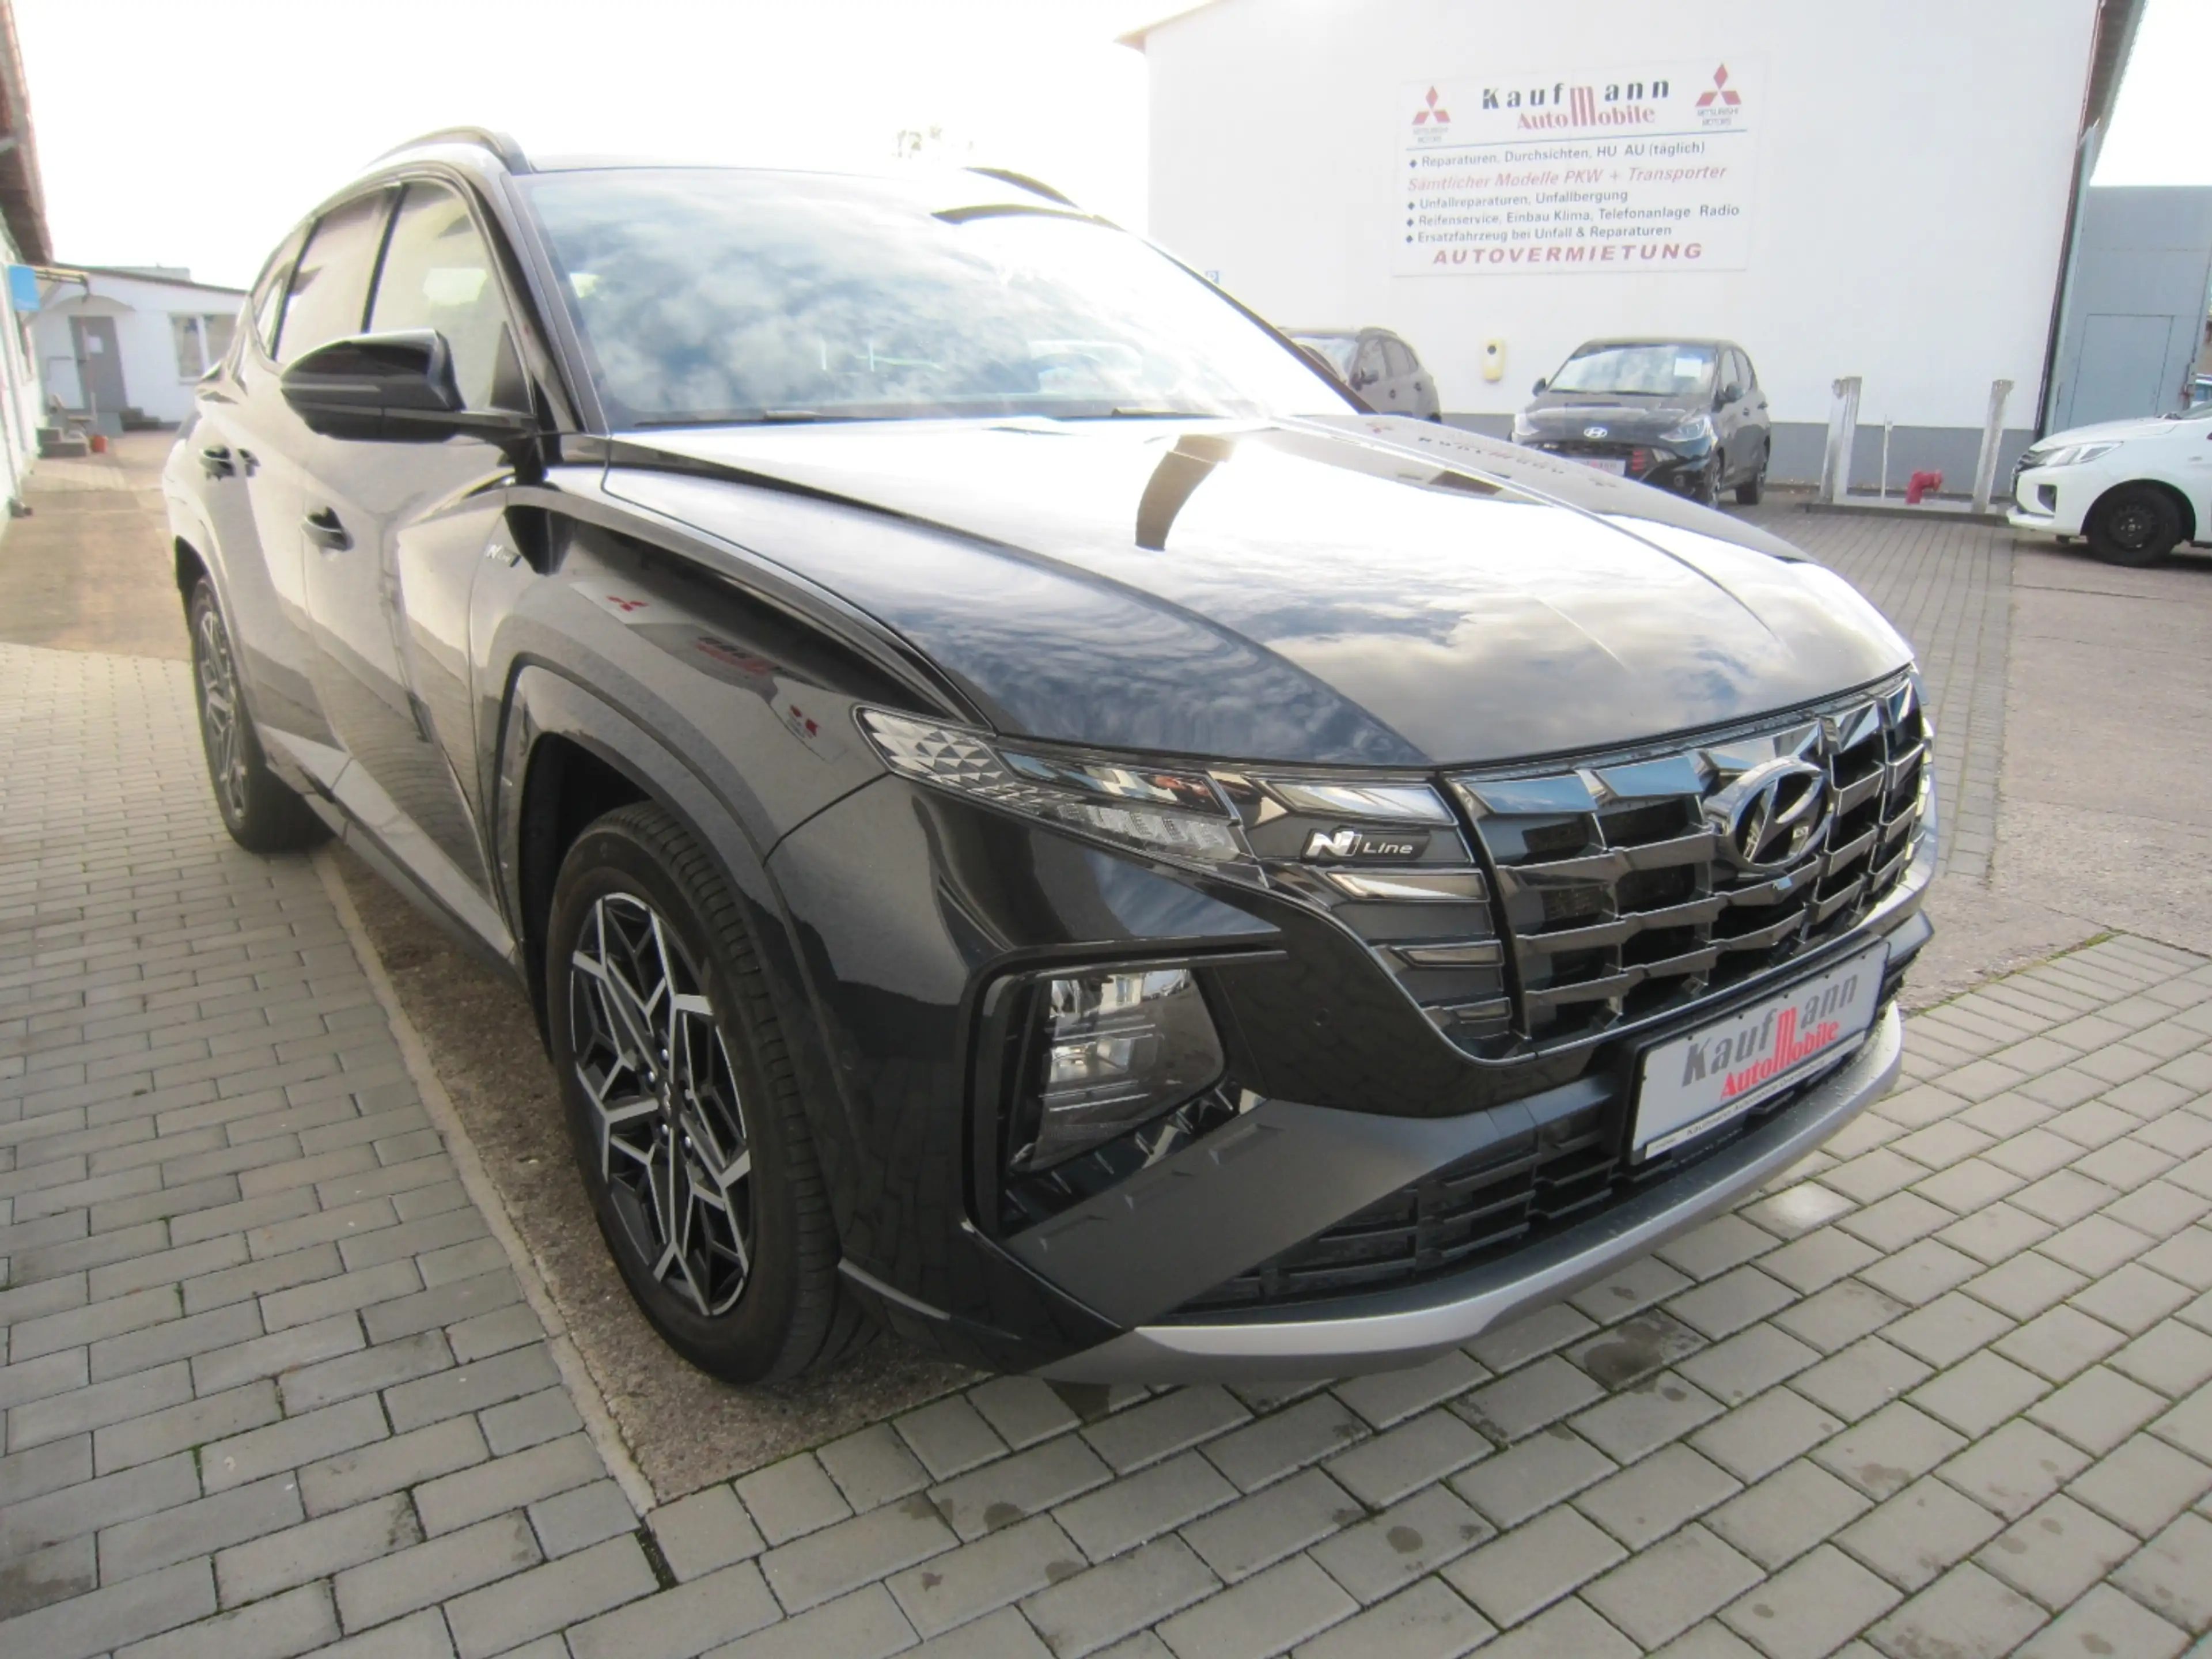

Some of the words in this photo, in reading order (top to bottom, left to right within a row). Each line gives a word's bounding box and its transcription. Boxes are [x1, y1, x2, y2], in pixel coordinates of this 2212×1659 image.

[1597, 145, 1617, 158] HU
[1624, 143, 1645, 156] AU
[1494, 171, 1559, 187] Modelle
[1564, 168, 1604, 183] PKW
[1609, 171, 1619, 181] +
[1628, 166, 1727, 183] Transporter
[1536, 191, 1628, 204] Unfallbergung
[1506, 211, 1550, 224] Einbau
[1599, 206, 1691, 220] Telefonanlage
[1699, 204, 1740, 217] Radio
[1418, 230, 1508, 243] Ersatzfahrzeug
[1512, 229, 1531, 240] bei
[1535, 227, 1572, 239] Unfall
[1576, 226, 1585, 237] &
[1590, 225, 1672, 240] Reparaturen
[1433, 243, 1702, 264] AUTOVERMIETUNG
